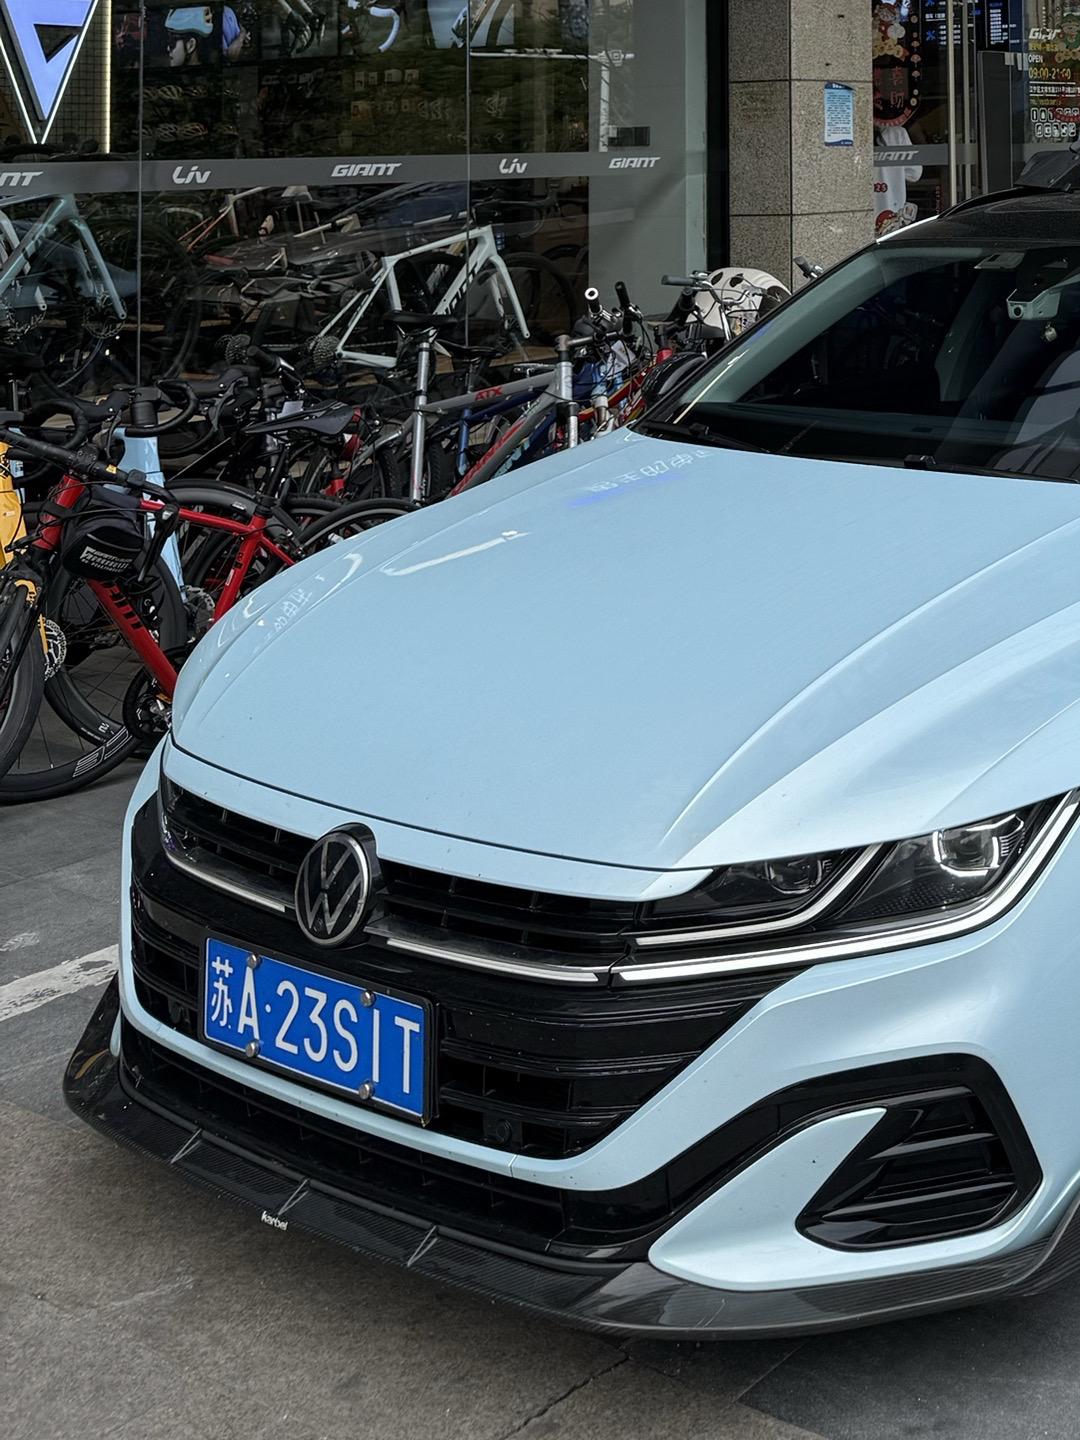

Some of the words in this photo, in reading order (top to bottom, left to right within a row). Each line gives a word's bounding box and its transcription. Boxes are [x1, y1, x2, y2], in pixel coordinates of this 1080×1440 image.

[331, 163, 402, 177] GIANT
[498, 158, 528, 174] Liv
[608, 156, 661, 169] GIANT
[172, 165, 212, 185] Liv
[475, 385, 502, 401] ATX
